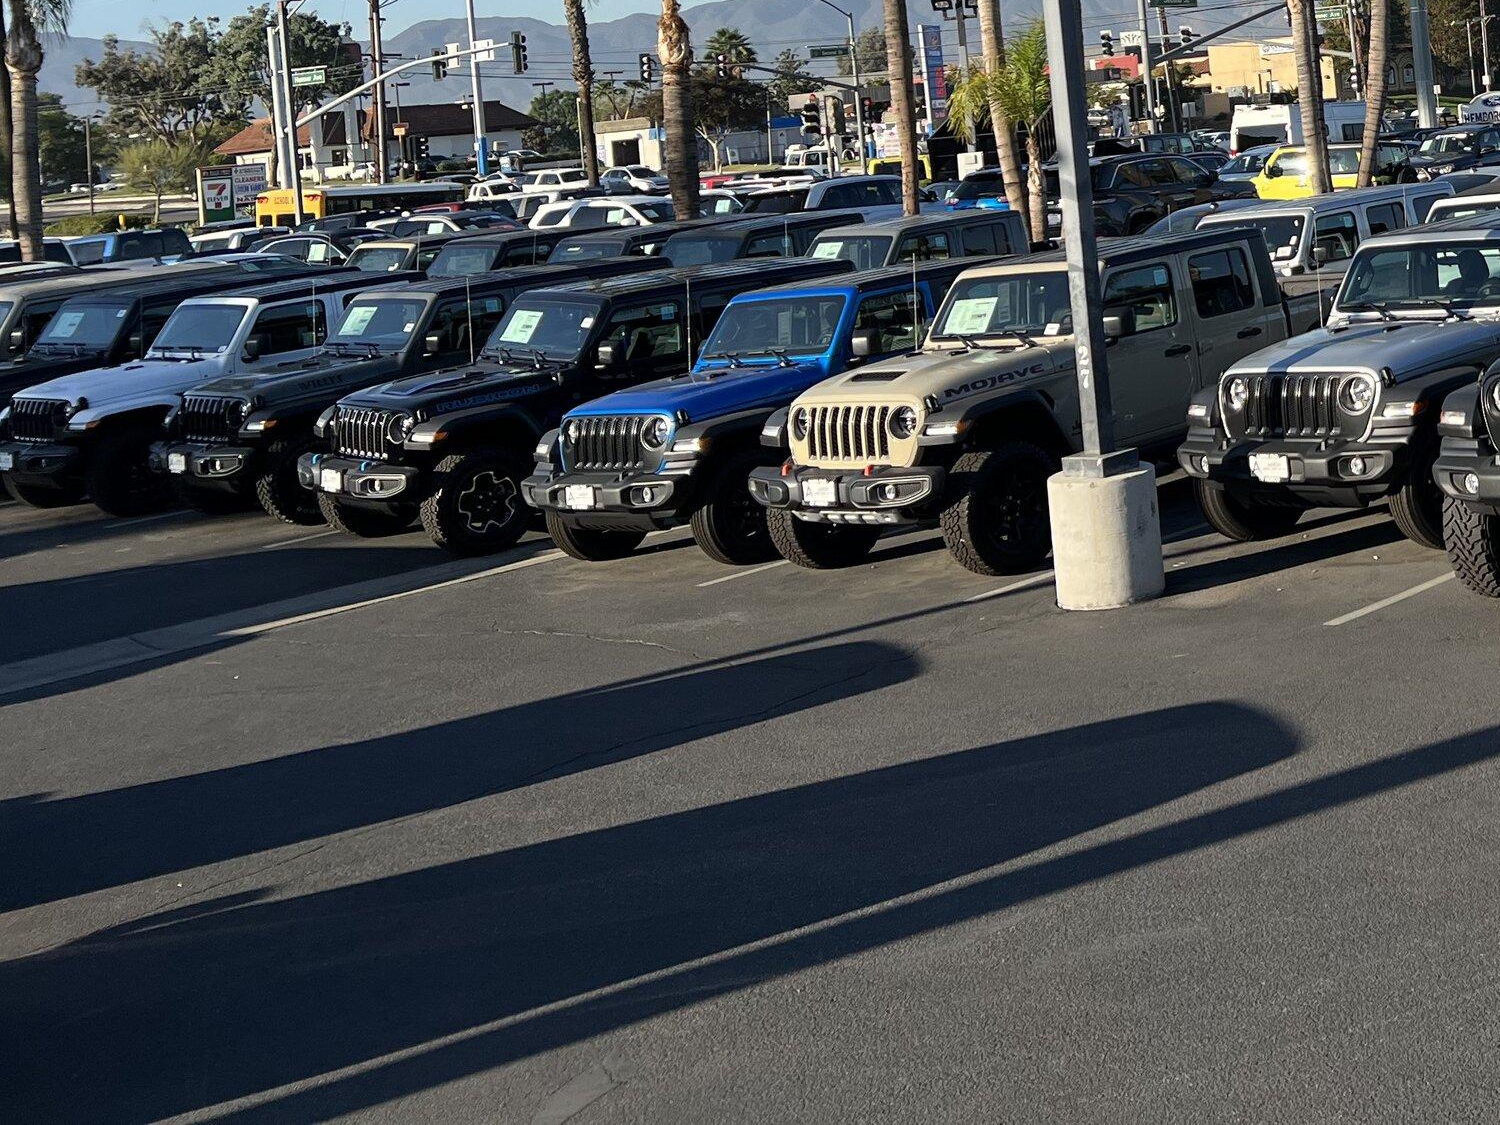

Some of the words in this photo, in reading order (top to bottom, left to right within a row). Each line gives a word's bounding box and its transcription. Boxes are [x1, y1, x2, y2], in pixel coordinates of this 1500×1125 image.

[943, 363, 1045, 398] MOJAVE
[1077, 345, 1090, 389] 27
[436, 383, 541, 412] RUBICON
